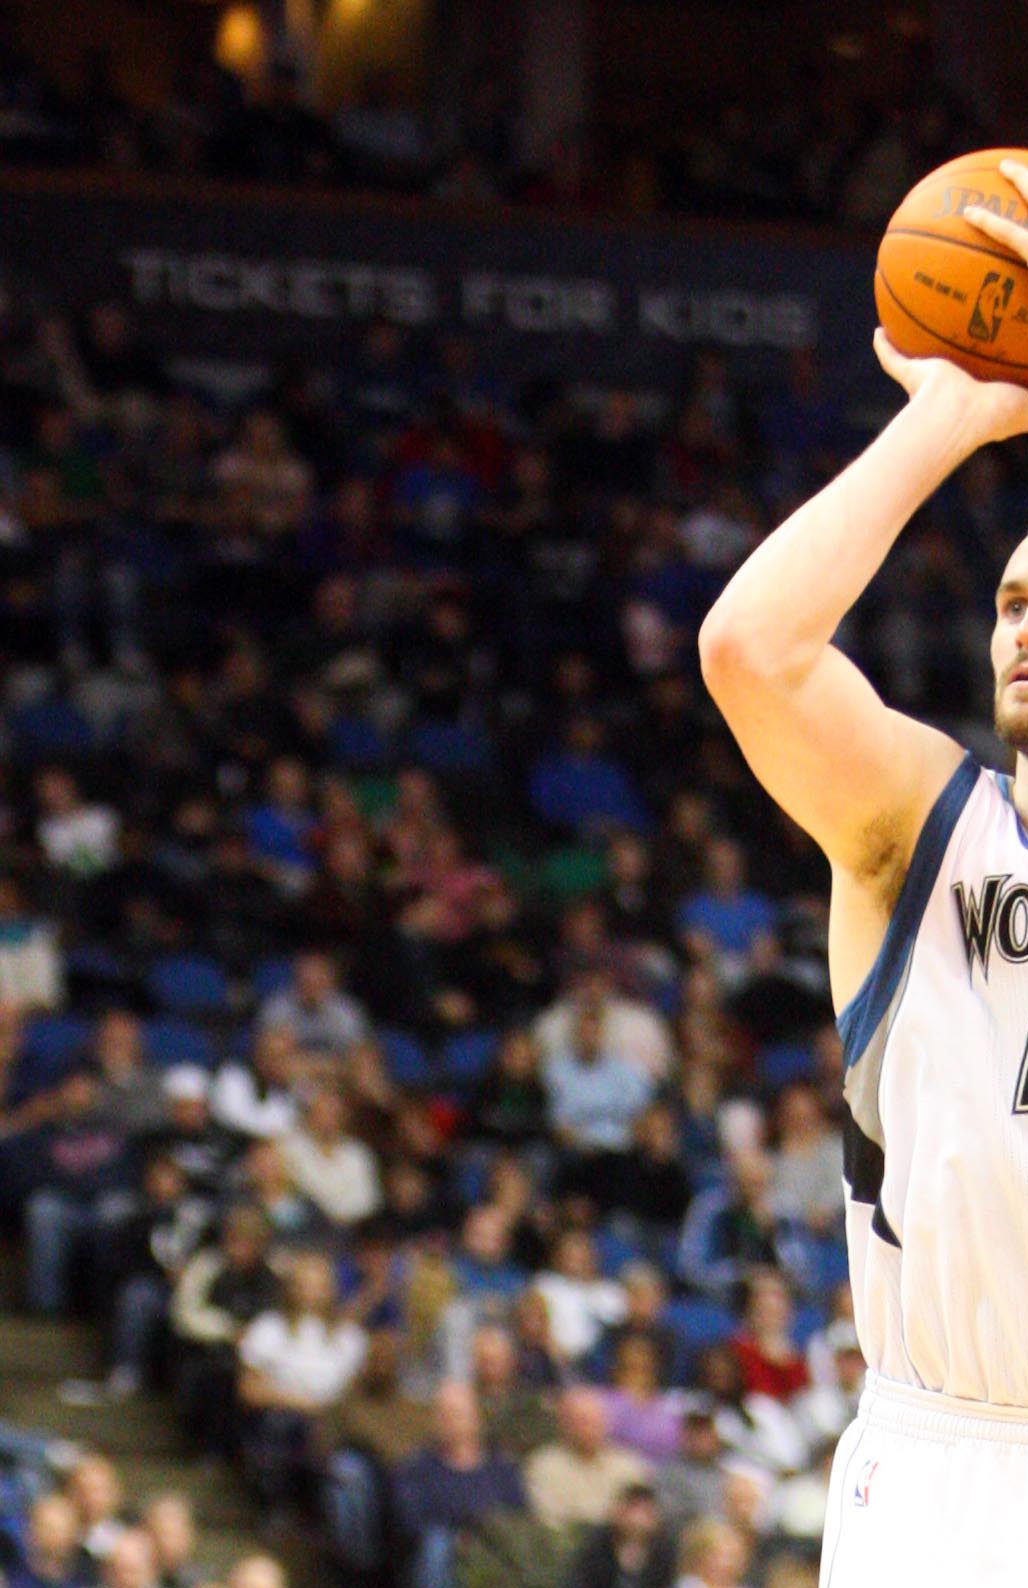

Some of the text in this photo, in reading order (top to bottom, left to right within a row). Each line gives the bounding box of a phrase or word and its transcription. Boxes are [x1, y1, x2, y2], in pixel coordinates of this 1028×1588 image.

[121, 247, 818, 348] TICKETS FOR KIDS
